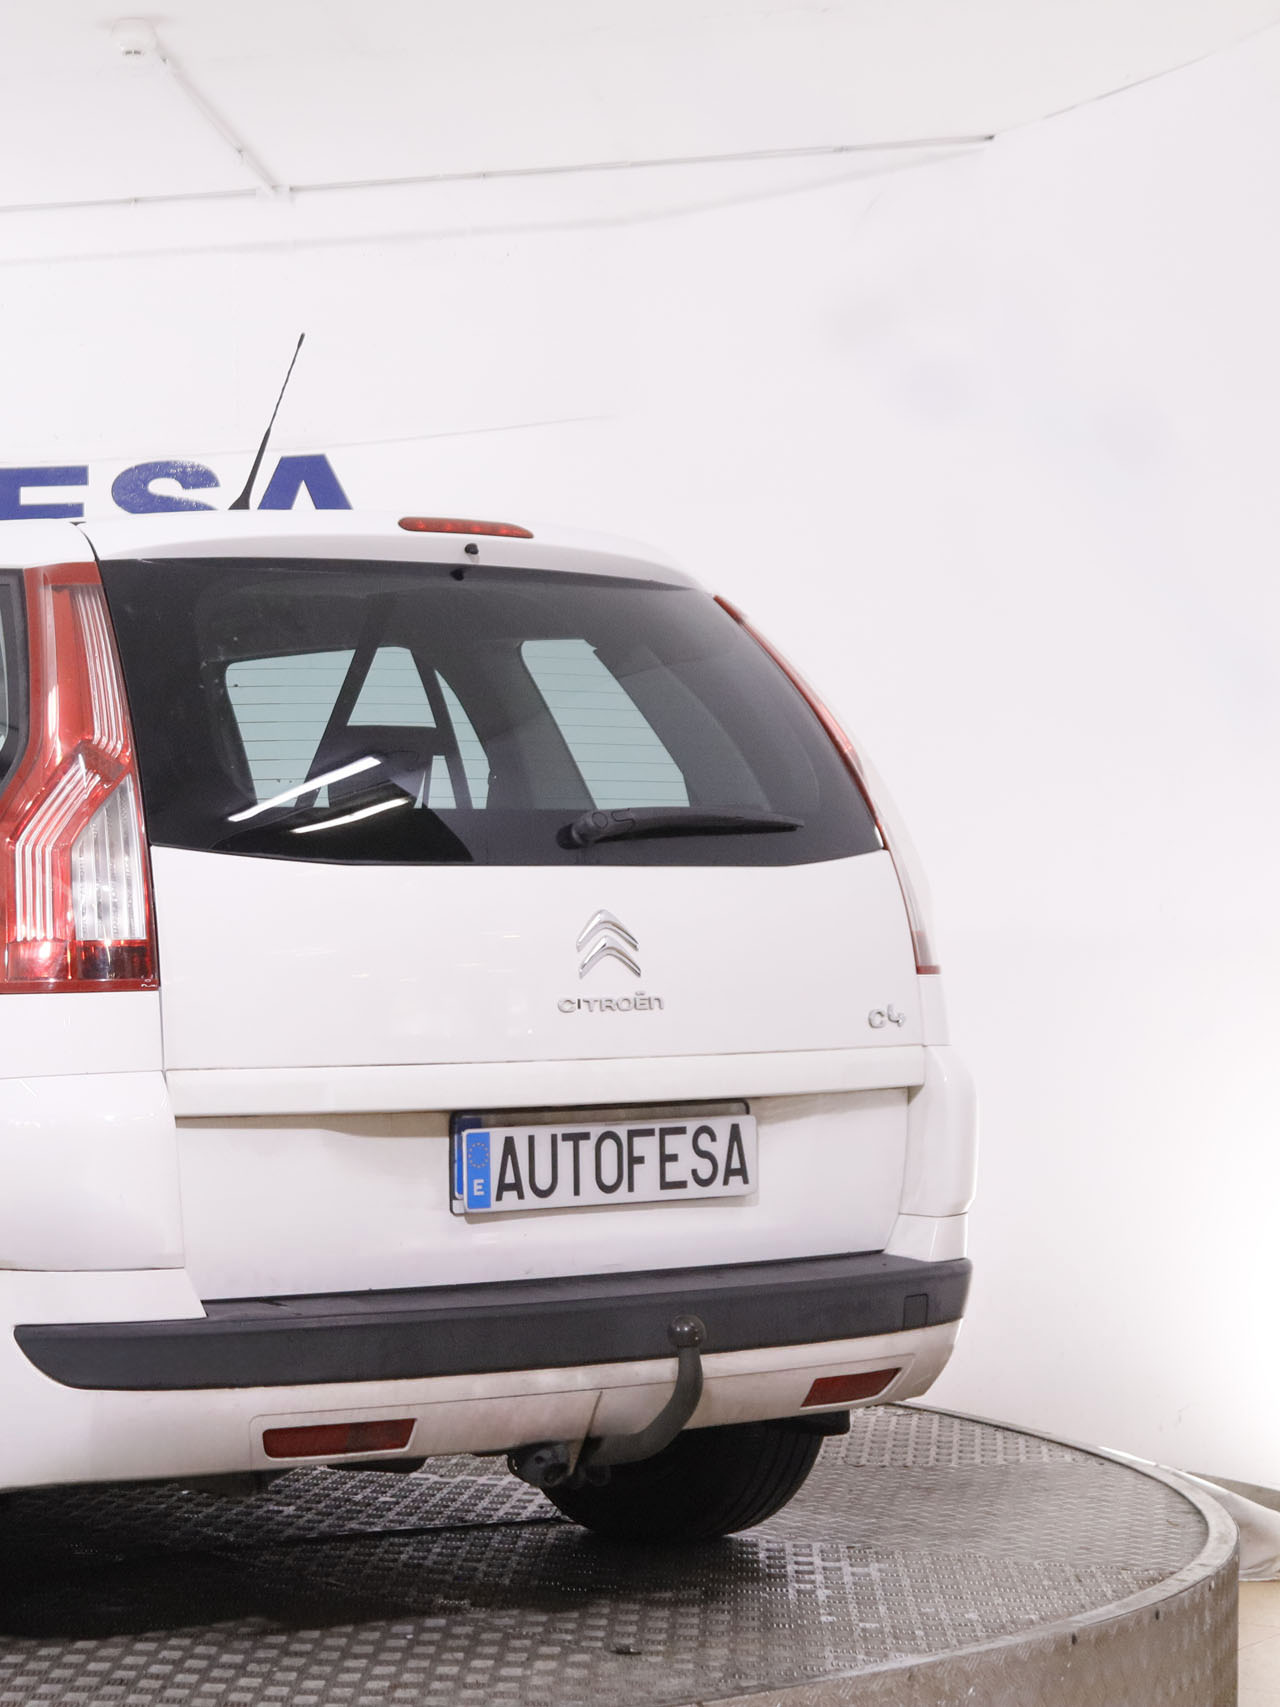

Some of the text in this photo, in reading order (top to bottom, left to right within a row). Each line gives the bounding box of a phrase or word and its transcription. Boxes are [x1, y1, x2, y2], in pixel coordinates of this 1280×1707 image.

[867, 1004, 907, 1029] C4
[473, 1123, 750, 1202] E AUTOFESA
